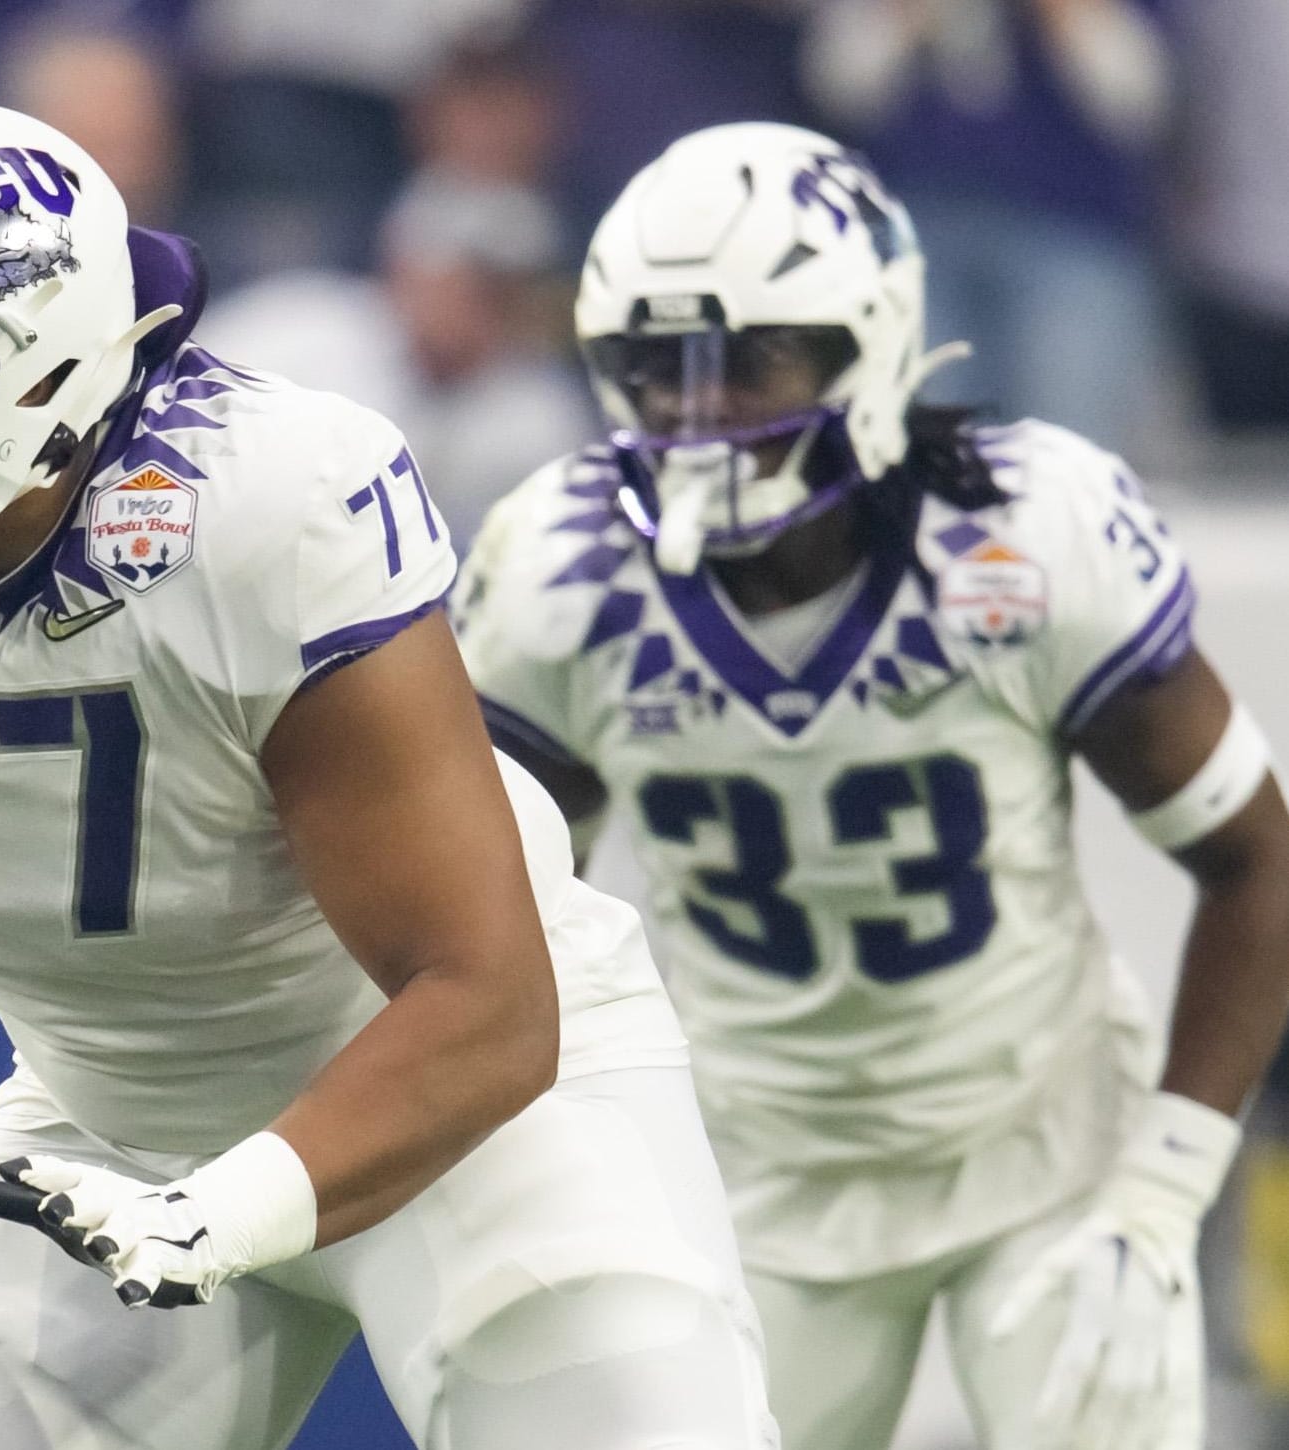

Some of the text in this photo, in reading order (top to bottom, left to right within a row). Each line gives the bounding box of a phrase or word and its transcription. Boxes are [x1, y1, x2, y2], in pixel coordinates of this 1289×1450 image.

[93, 517, 192, 539] Fiesta Bowl
[117, 496, 173, 516] Vrbo
[346, 447, 440, 581] 77
[639, 752, 999, 985] 33
